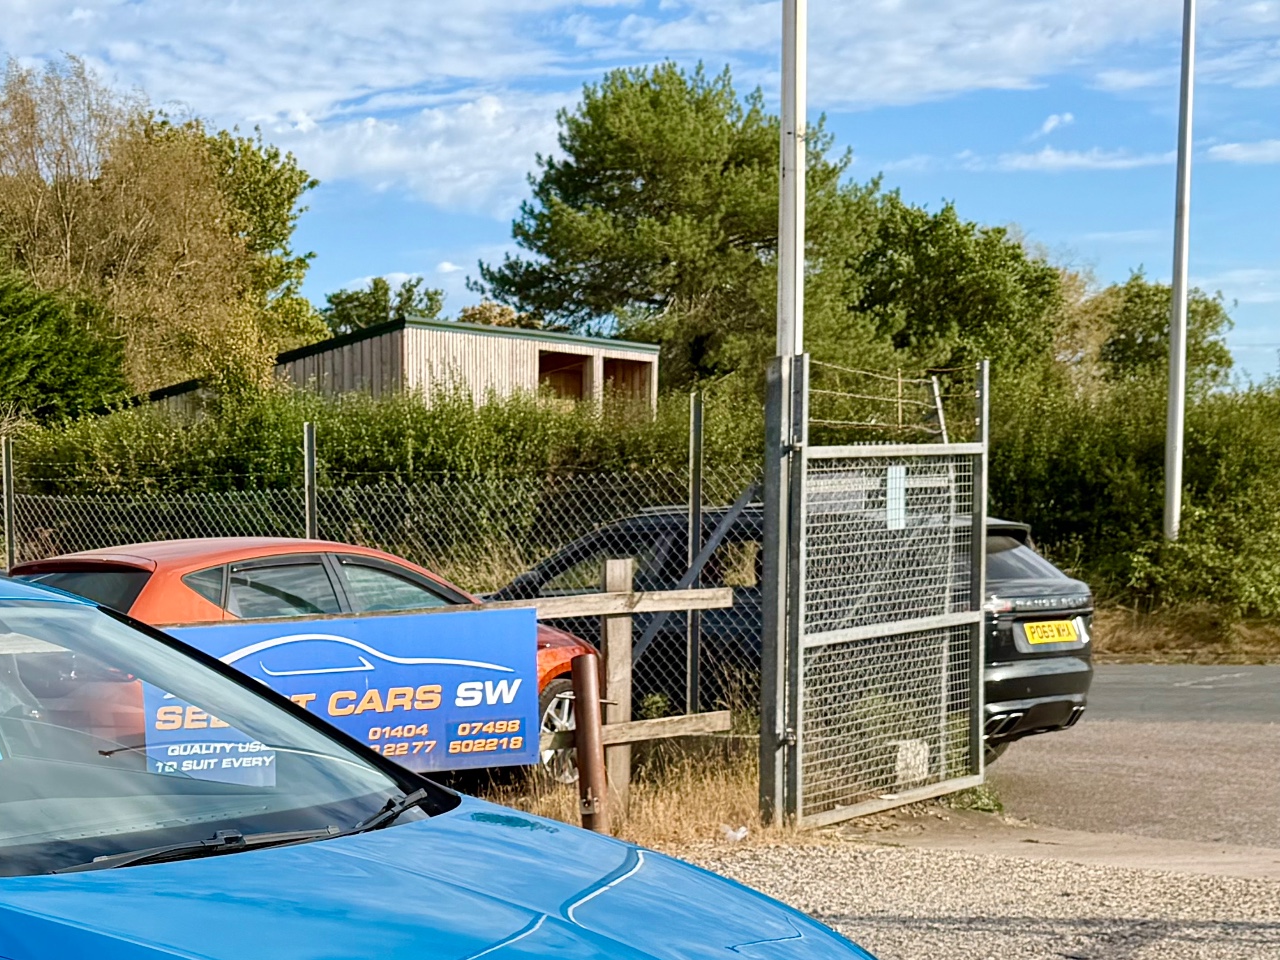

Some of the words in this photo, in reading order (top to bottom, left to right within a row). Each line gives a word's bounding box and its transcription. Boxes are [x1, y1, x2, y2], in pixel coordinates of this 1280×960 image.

[327, 684, 443, 717] CARS
[454, 678, 523, 708] SW
[368, 723, 429, 741] 01404
[457, 719, 521, 736] 07498
[167, 743, 235, 756] QUALITY
[448, 736, 524, 755] 502218
[181, 758, 219, 771] SUIT
[221, 755, 276, 768] EVERY
